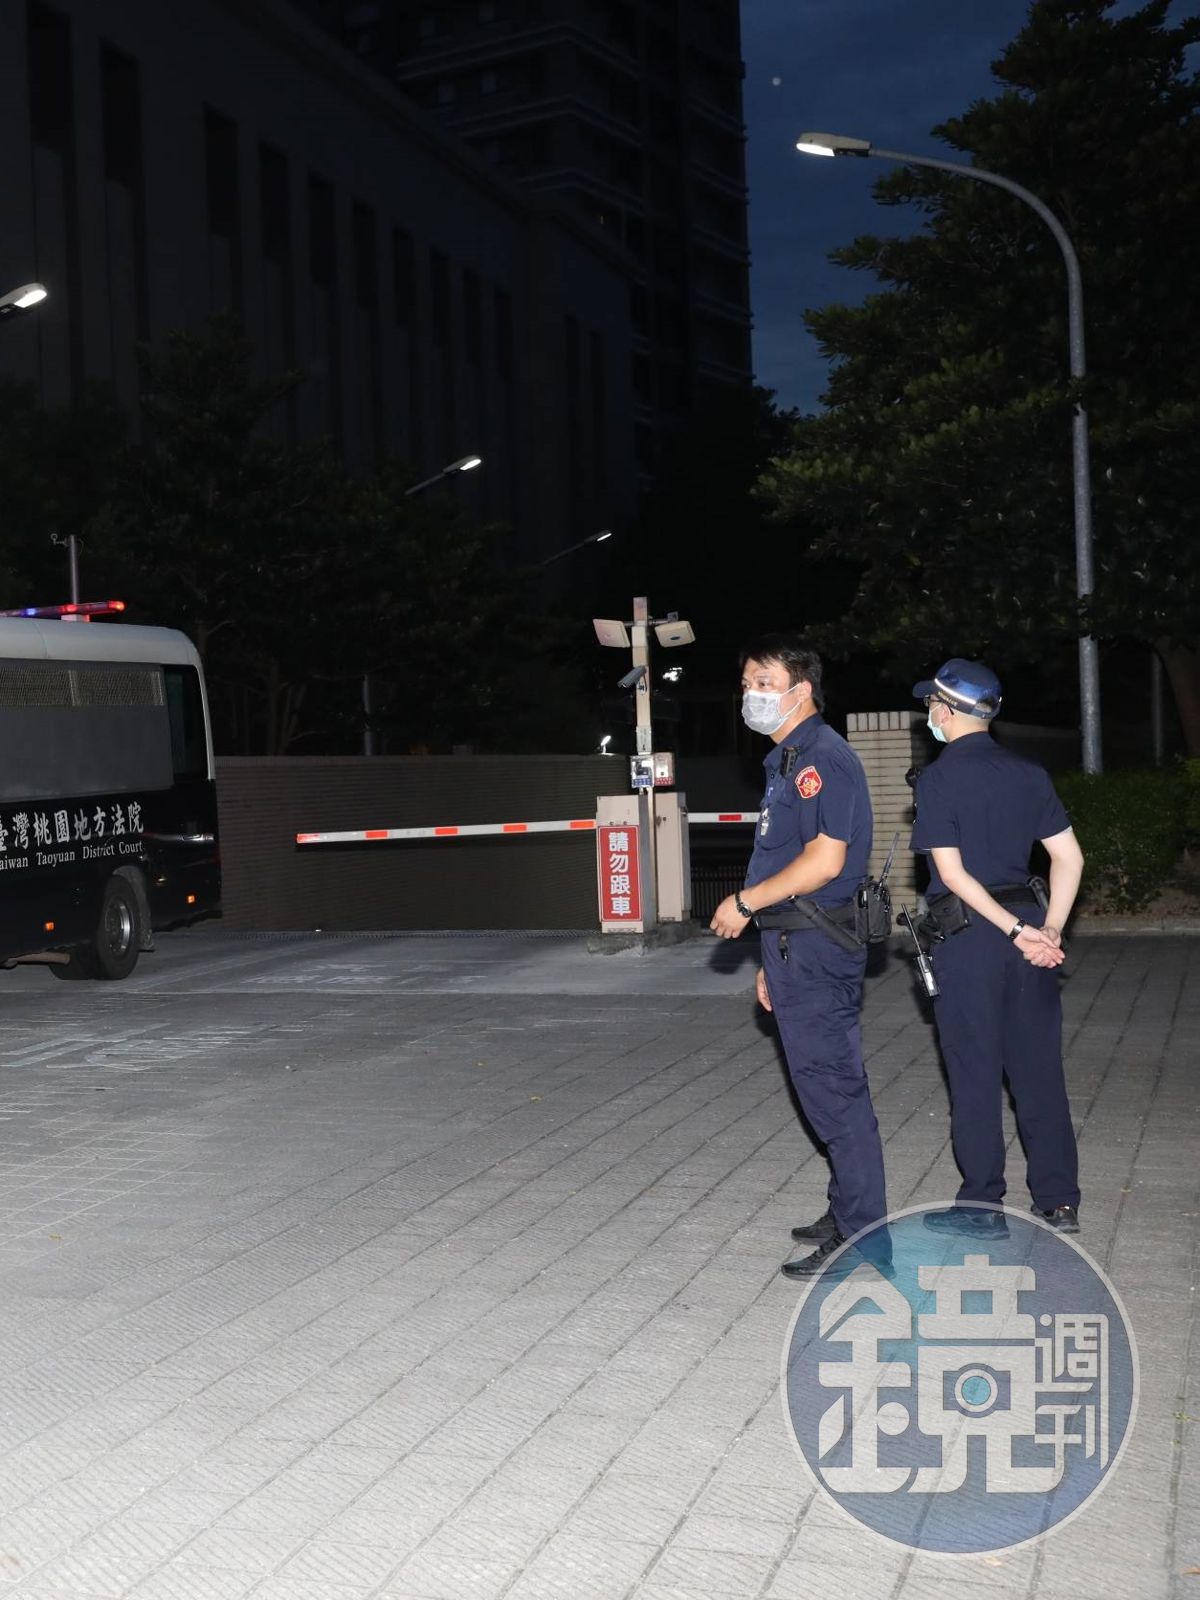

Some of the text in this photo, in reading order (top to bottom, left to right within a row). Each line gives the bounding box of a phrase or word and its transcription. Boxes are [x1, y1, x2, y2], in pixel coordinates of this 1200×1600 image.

[36, 850, 75, 867] Taoyuan
[82, 844, 115, 860] District
[118, 840, 143, 855] Court
[608, 831, 631, 916] 請勿跟車
